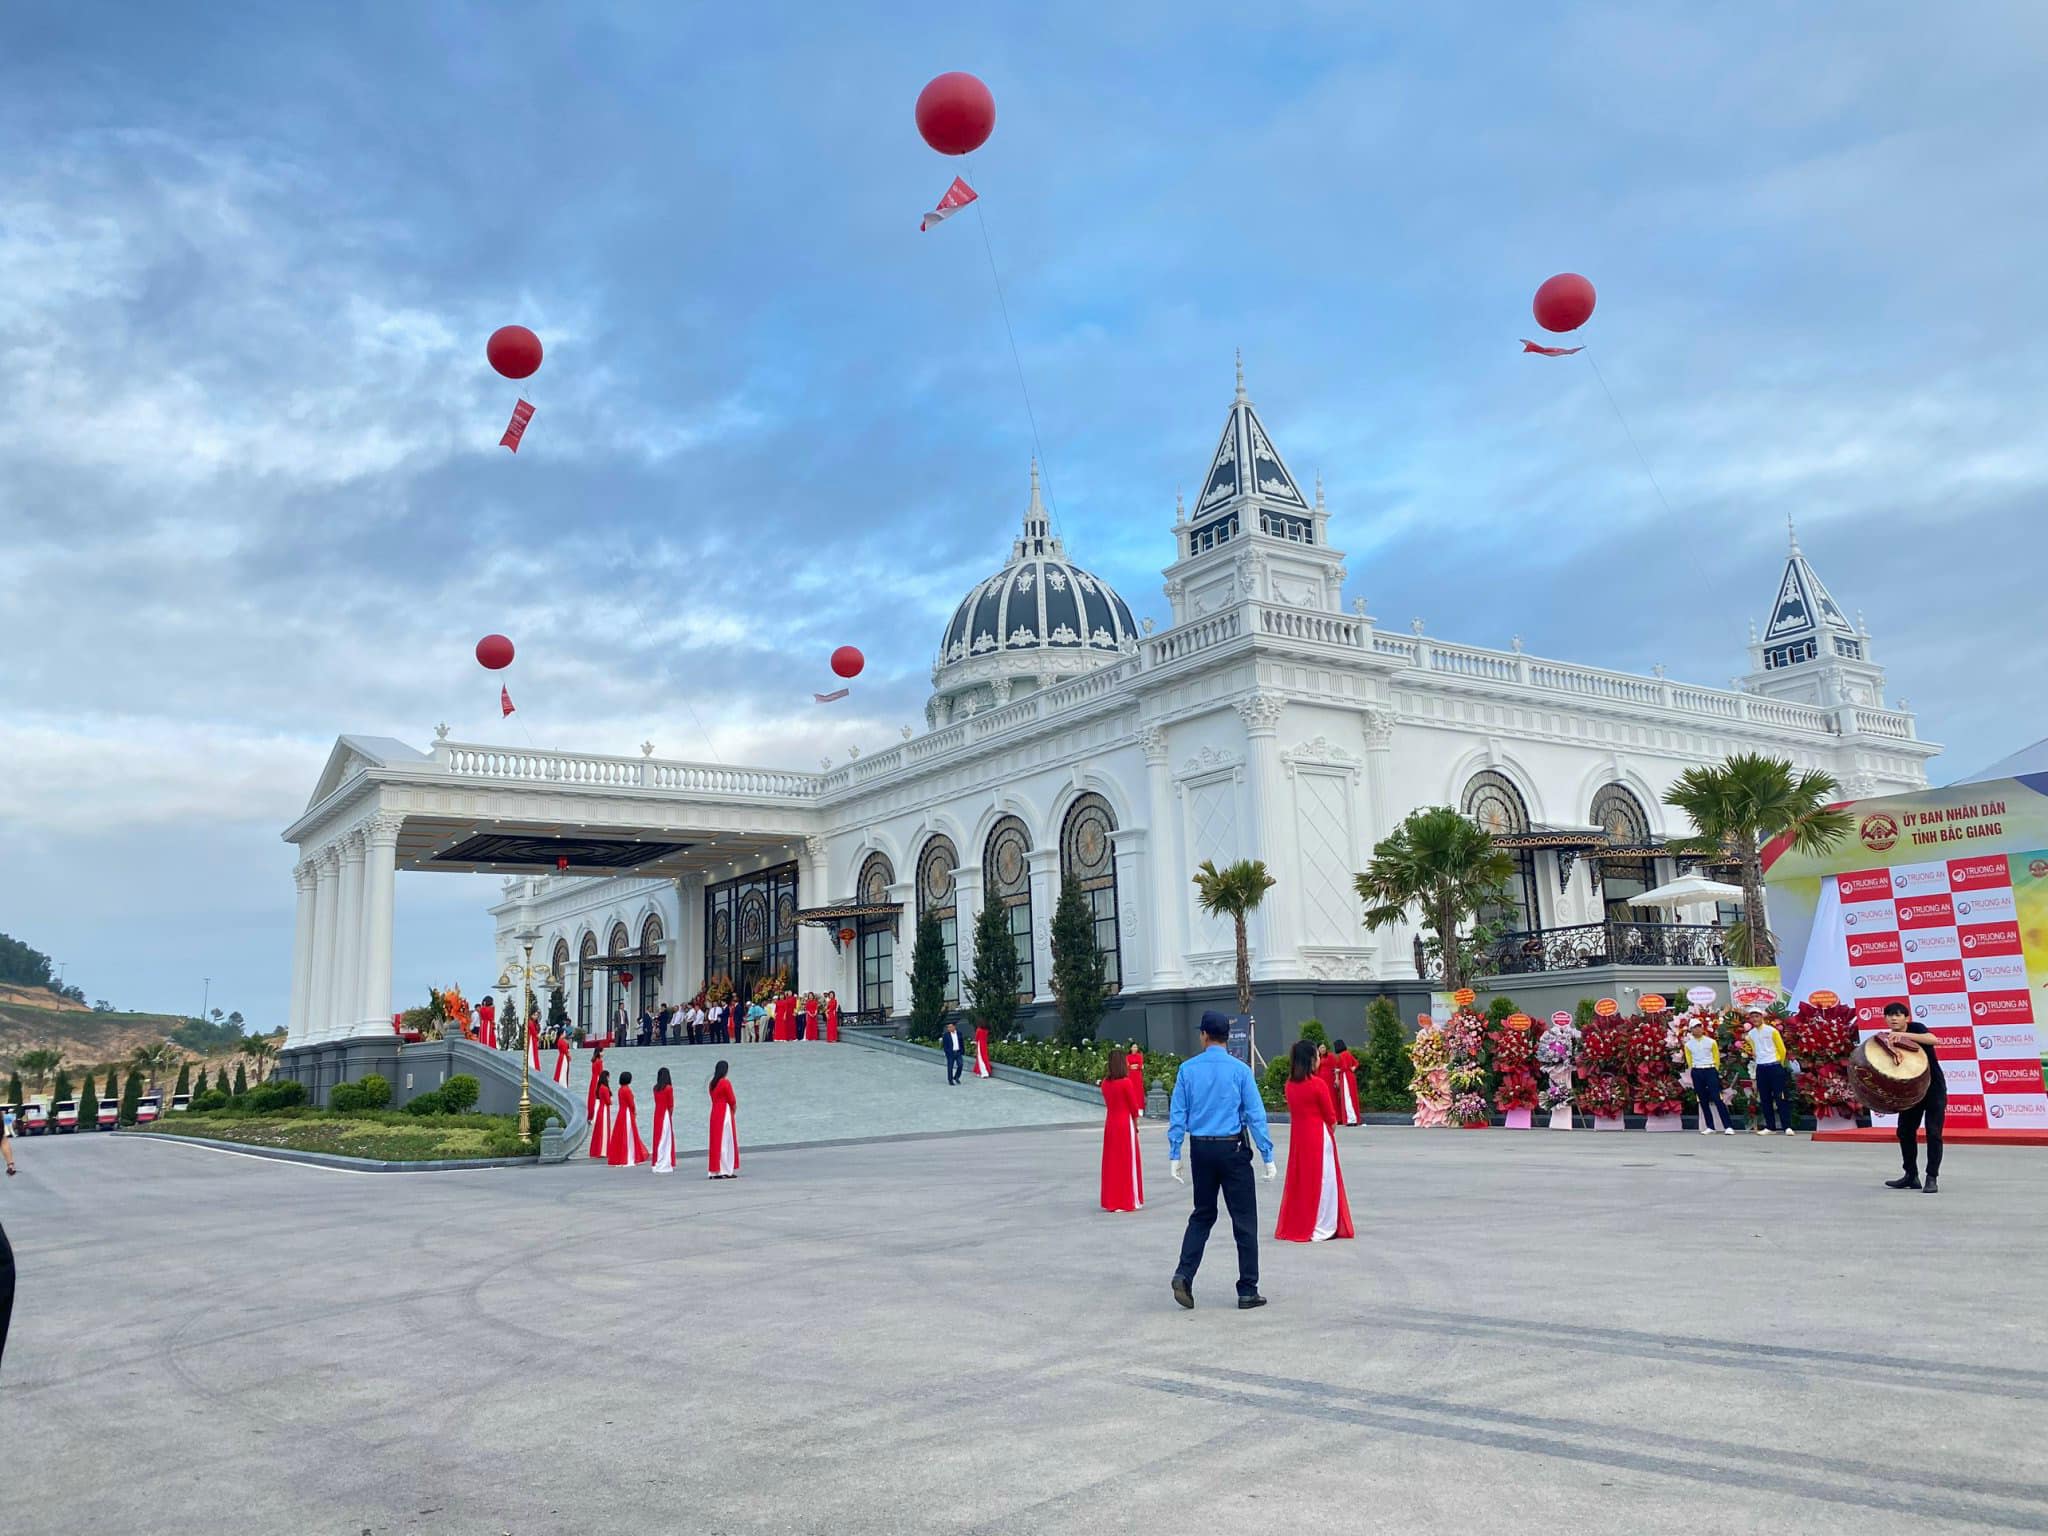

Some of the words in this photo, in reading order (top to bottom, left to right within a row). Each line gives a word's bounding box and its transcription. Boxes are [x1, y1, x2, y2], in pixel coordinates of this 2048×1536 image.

[1903, 810, 1917, 827] ỦY
[1920, 809, 1944, 825] BAN
[1946, 804, 1979, 821] NHÂN
[1981, 801, 2006, 817] DÂN
[1912, 828, 1938, 845] TỈNH
[1940, 825, 1963, 842] BẮC
[1966, 822, 2002, 838] GIANG
[1996, 863, 2006, 872] AN
[1936, 871, 1945, 879] AN
[1880, 877, 1888, 885] AN
[2001, 897, 2011, 905] AN
[1941, 903, 1951, 911] AN
[1884, 909, 1893, 917] AN
[2006, 931, 2016, 939] AN
[1947, 936, 1956, 944] AN
[1889, 941, 1898, 949] AN
[1951, 969, 1961, 977] AN
[2012, 966, 2022, 974] AN
[1957, 1002, 1966, 1010] AN
[2018, 999, 2028, 1008] AN
[1962, 1036, 1972, 1044] AN
[1967, 1070, 1977, 1078] AN
[2029, 1069, 2040, 1077] AN
[1973, 1104, 1983, 1112] AN
